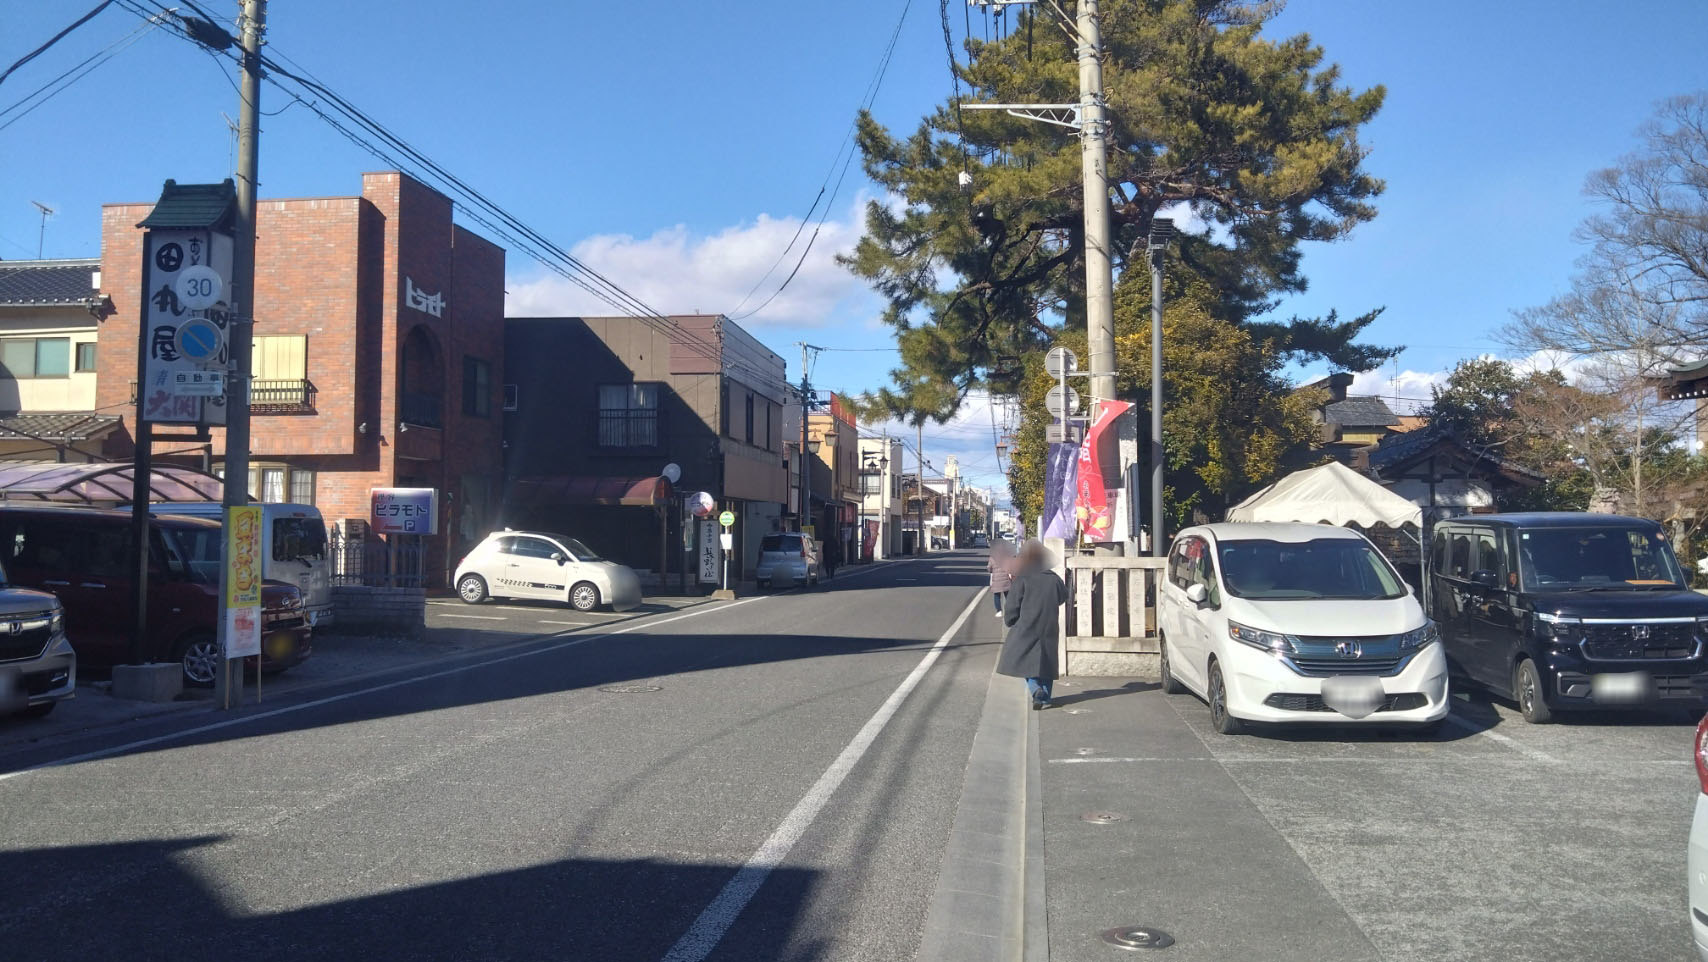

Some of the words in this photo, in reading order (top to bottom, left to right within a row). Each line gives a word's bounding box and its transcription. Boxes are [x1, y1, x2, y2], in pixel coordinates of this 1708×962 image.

[187, 278, 212, 297] 30
[176, 373, 220, 383] 自動車
[375, 503, 427, 517] ヒラモト
